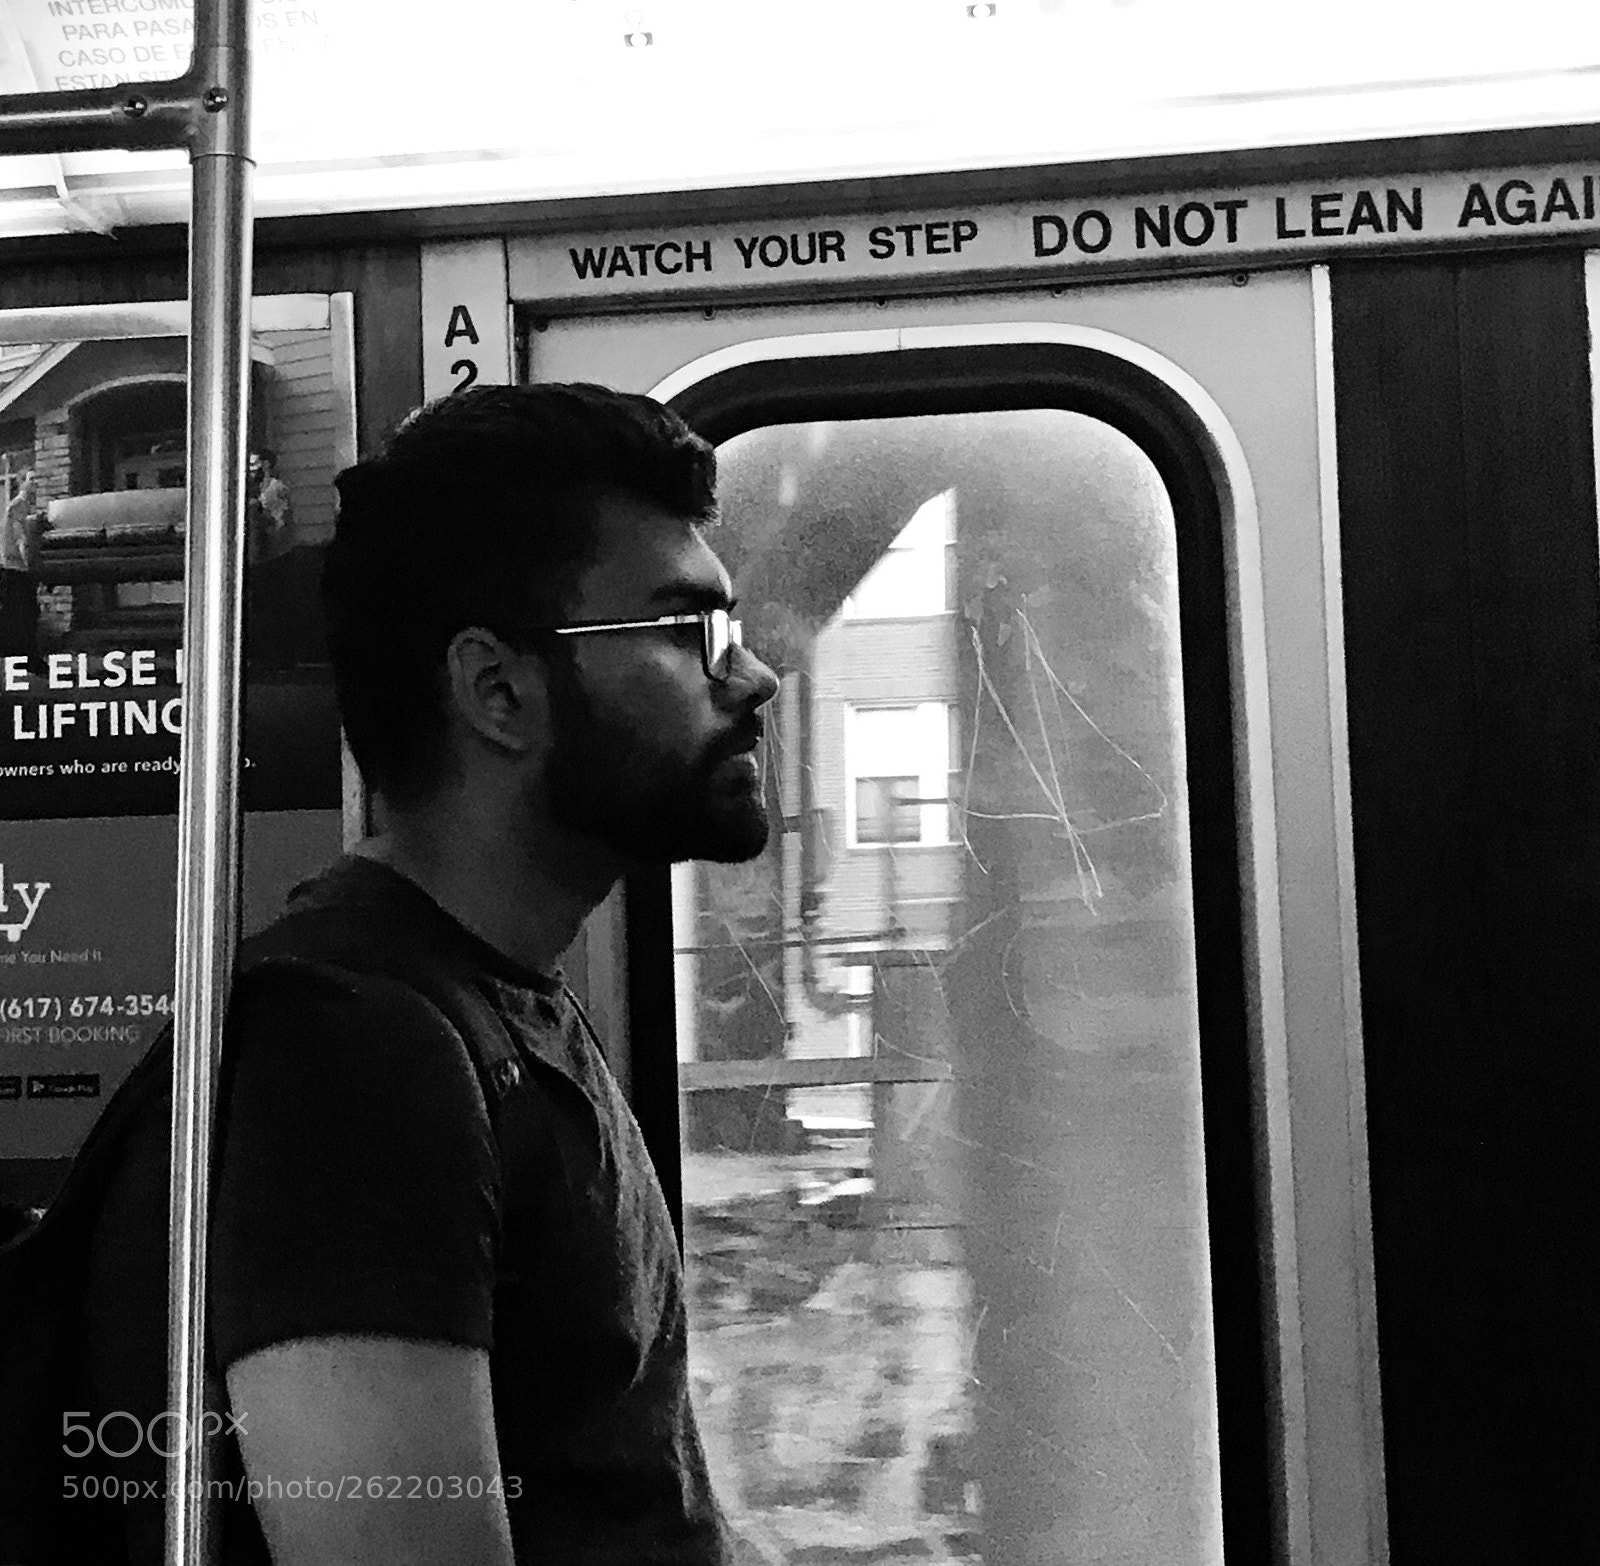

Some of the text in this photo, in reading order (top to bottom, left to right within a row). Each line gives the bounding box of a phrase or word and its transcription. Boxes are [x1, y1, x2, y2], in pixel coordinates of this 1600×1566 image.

[62, 22, 128, 40] PARA
[58, 47, 125, 67] CASO
[134, 45, 165, 62] DE
[1033, 174, 1600, 257] DO NOT LEAN AGAI
[569, 220, 978, 279] WATCH YOUR STEP
[444, 305, 480, 348] A
[48, 650, 157, 689] ELSE
[59, 759, 95, 774] who
[101, 760, 128, 773] are
[134, 755, 181, 774] ready
[21, 950, 46, 963] You
[50, 948, 89, 962] Need
[0, 997, 62, 1022] (617)
